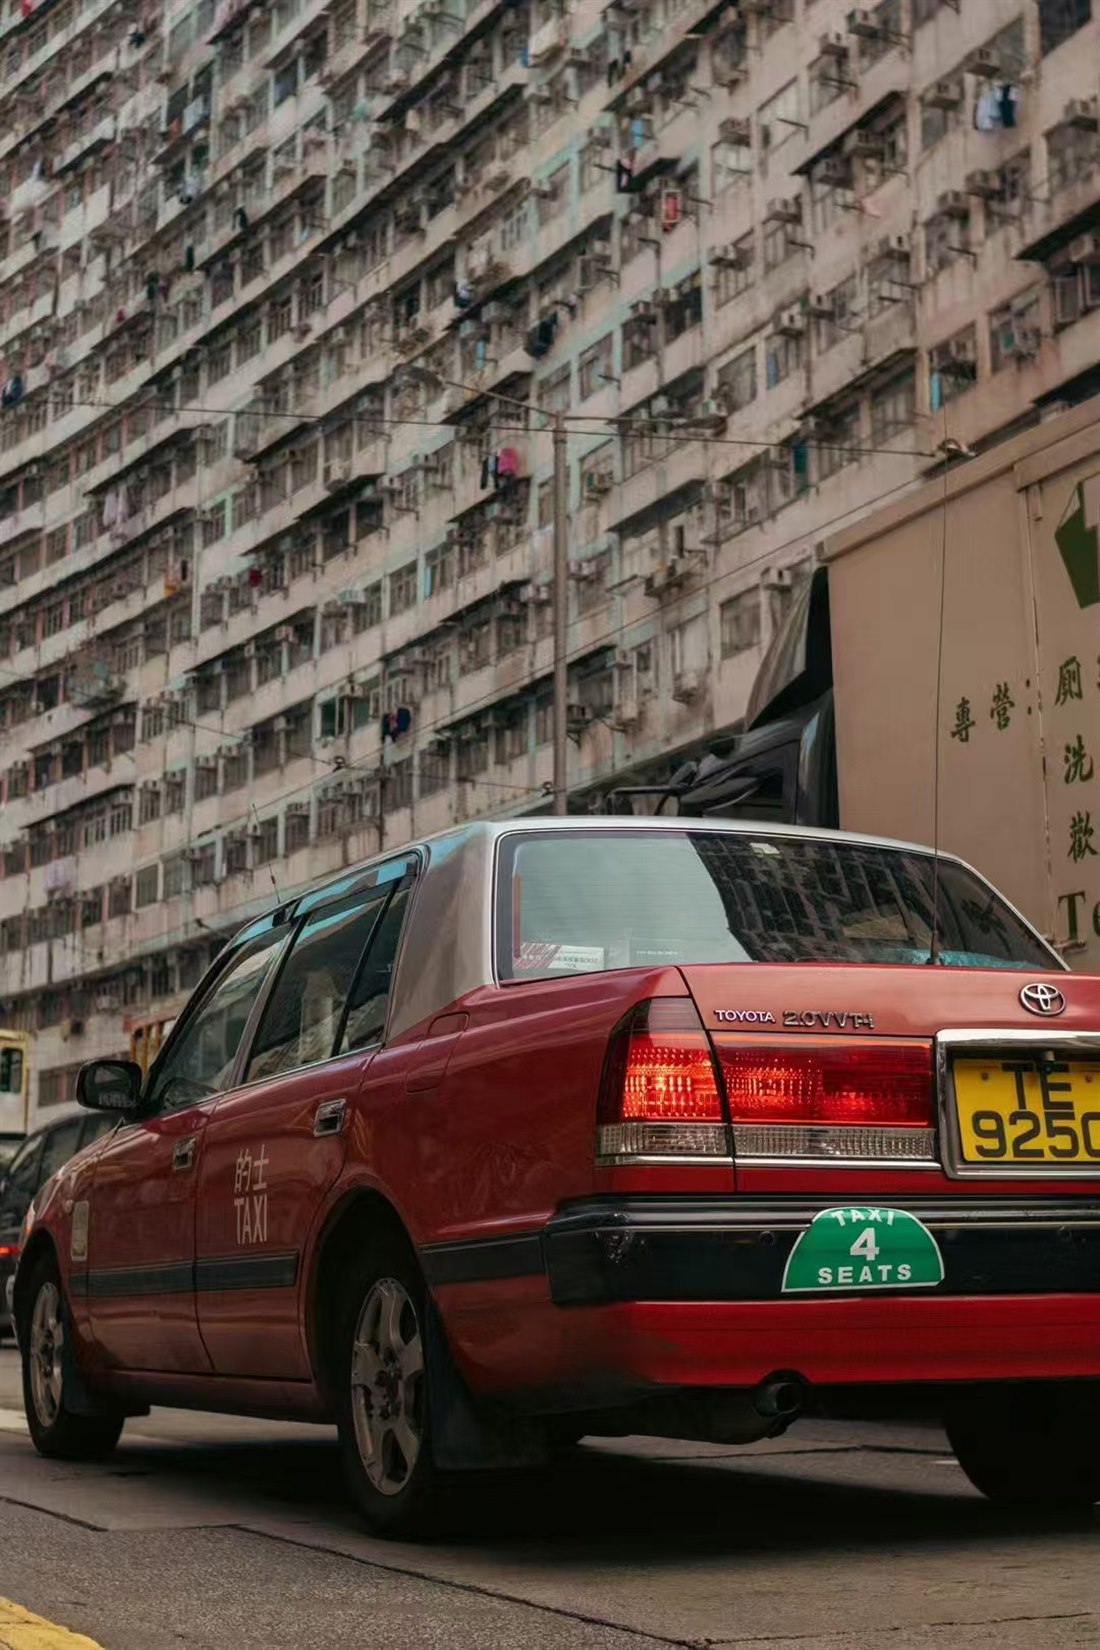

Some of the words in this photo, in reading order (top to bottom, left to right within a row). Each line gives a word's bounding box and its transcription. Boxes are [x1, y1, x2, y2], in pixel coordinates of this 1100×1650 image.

[1064, 734, 1094, 784] 洗
[714, 1009, 776, 1023] TOYOTA
[1001, 1062, 1074, 1110] TE
[234, 1144, 270, 1194] 的士
[234, 1193, 268, 1245] TAXI
[830, 1207, 895, 1227] TAXI
[850, 1227, 880, 1261] 4
[818, 1264, 912, 1284] SEATS
